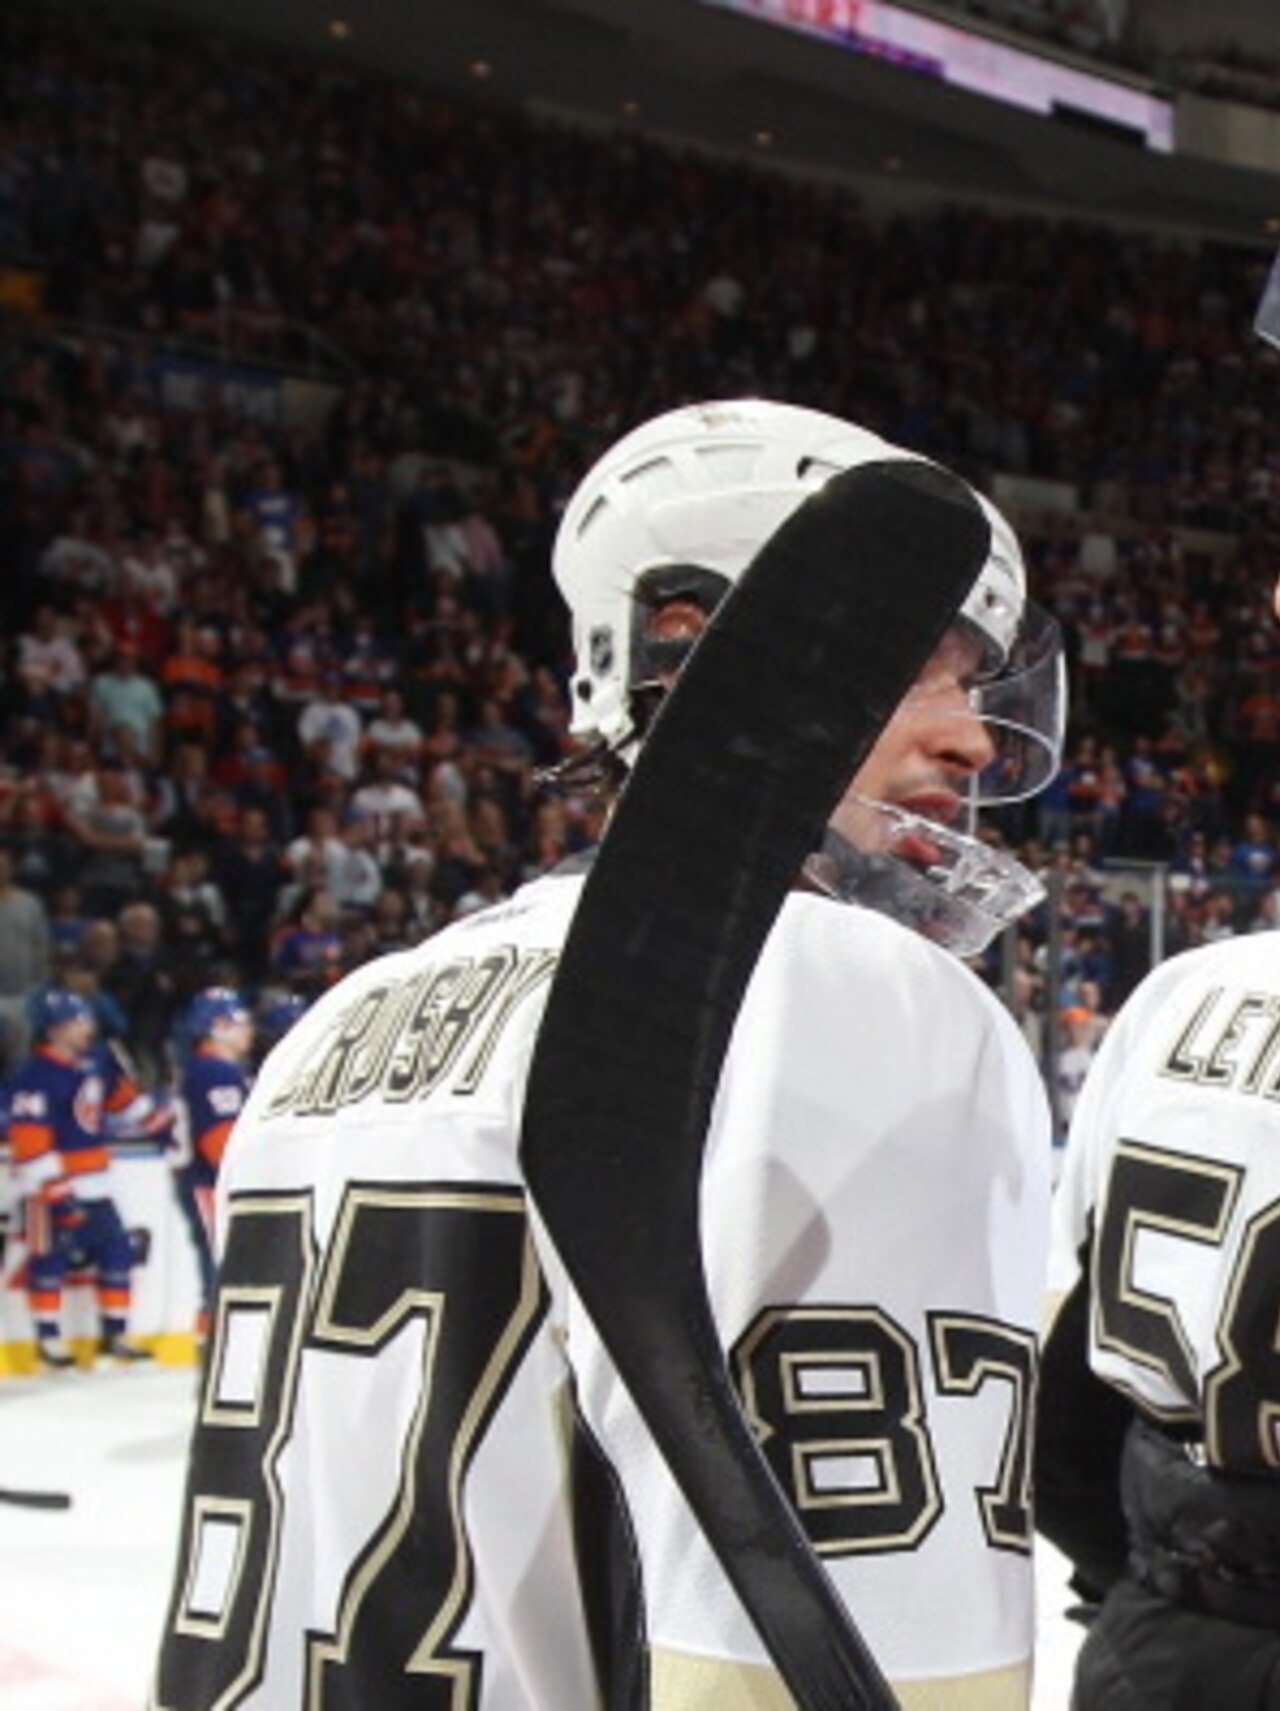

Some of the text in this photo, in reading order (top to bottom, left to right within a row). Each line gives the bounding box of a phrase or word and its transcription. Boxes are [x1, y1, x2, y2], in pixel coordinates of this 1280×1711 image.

[259, 944, 562, 1121] ROSBY
[157, 1180, 552, 1711] 87
[727, 1305, 1040, 1559] 87
